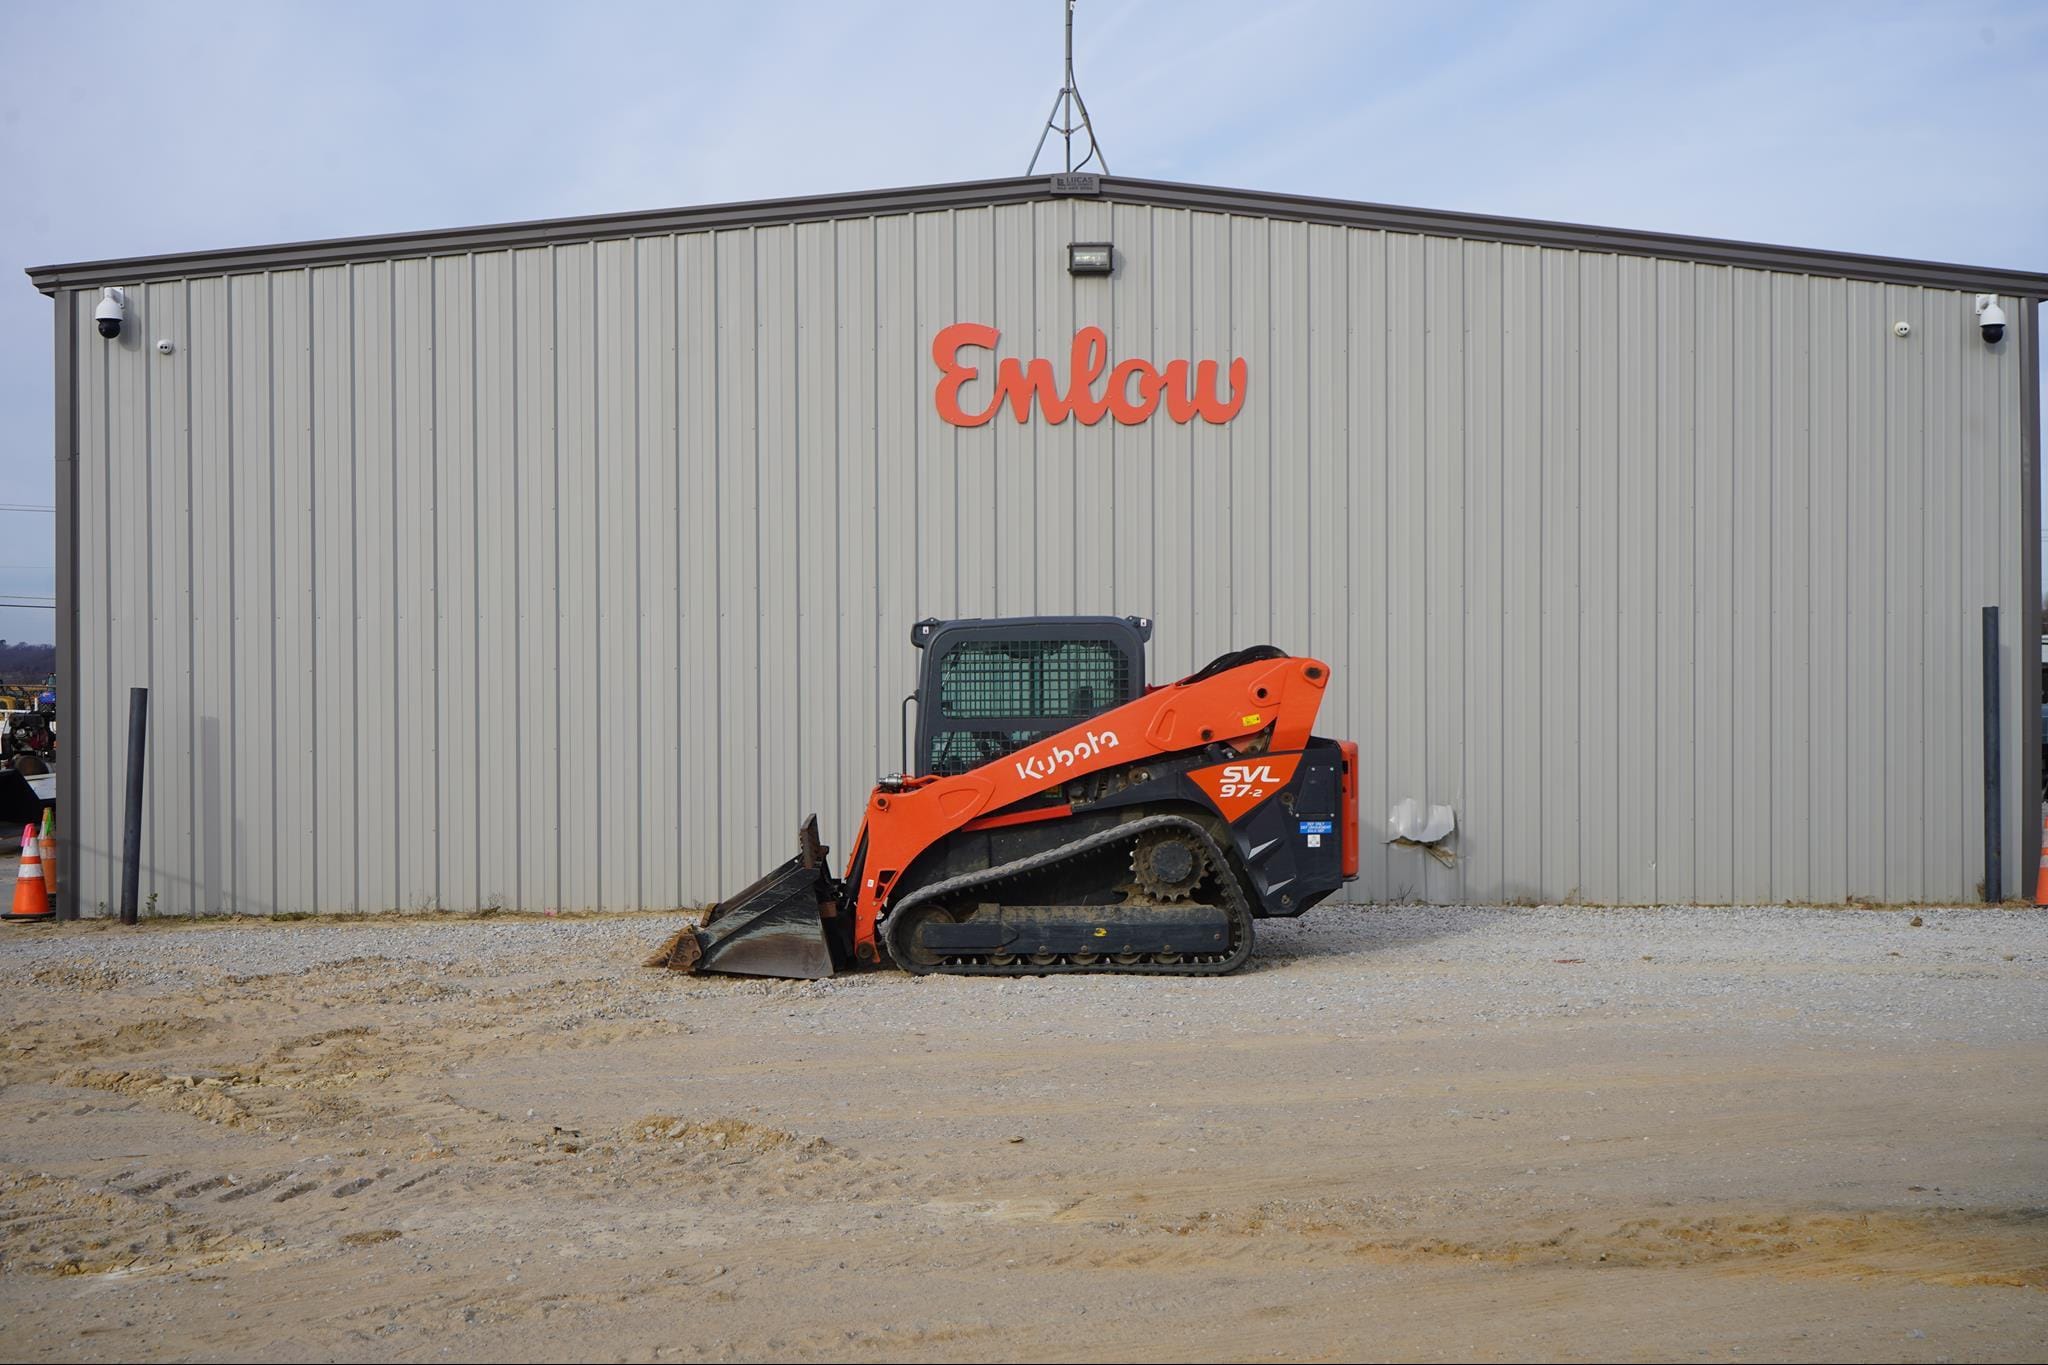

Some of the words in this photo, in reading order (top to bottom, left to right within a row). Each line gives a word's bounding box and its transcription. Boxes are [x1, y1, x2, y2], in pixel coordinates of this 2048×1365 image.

[932, 322, 1247, 427] Enlow
[1015, 731, 1119, 779] Kubota
[1219, 766, 1280, 782] SVL
[1220, 784, 1263, 797] 97-2
